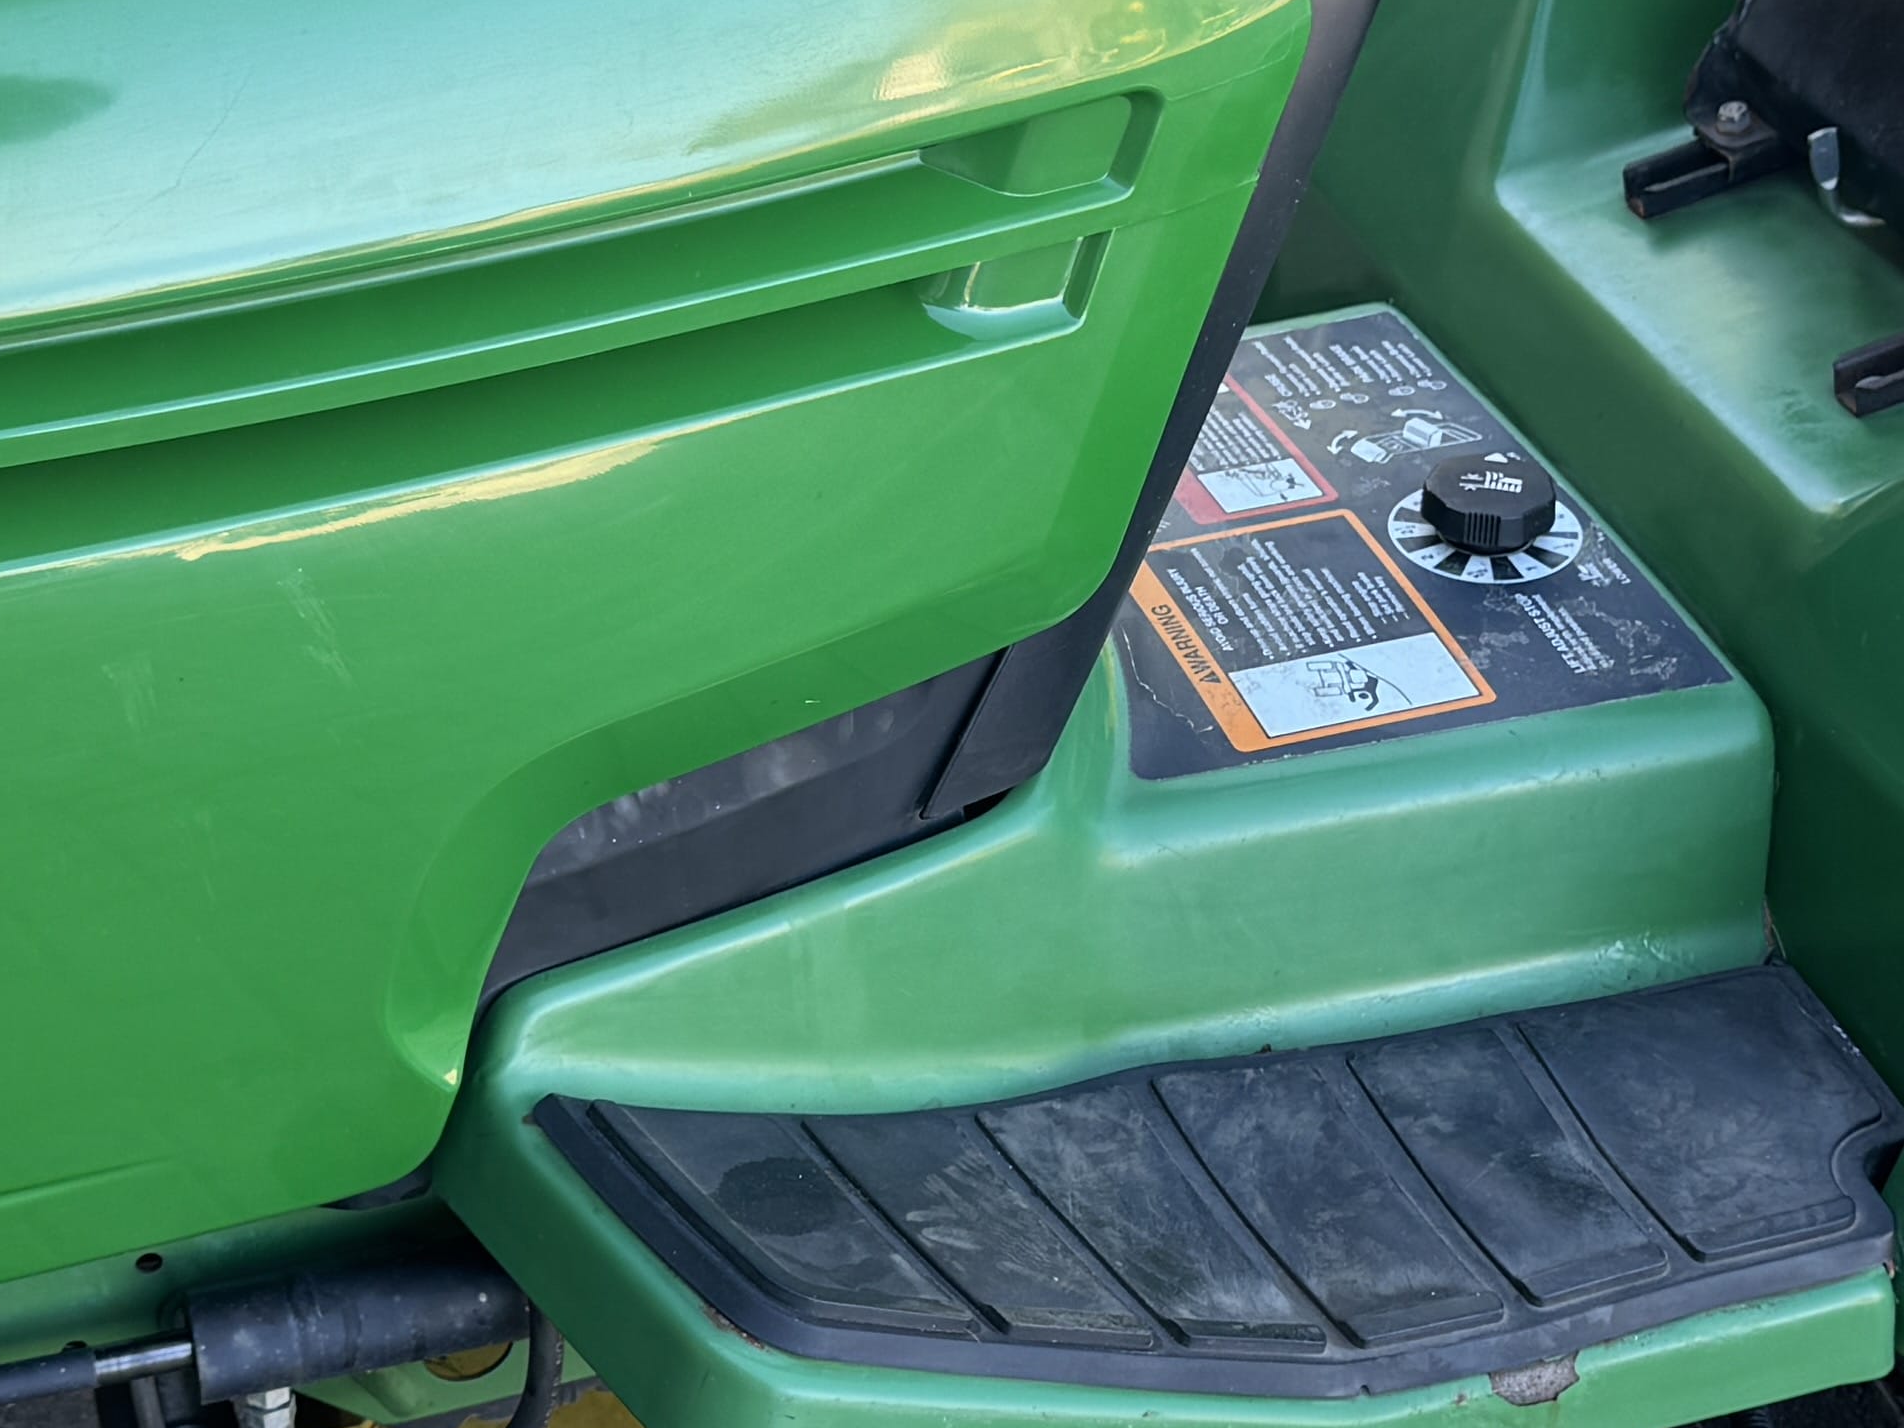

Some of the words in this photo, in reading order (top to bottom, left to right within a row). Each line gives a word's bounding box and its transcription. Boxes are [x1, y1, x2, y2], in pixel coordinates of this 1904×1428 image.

[1166, 567, 1193, 594] INJURY
[1184, 593, 1216, 627] SERIOUS
[1195, 585, 1220, 611] DEATH
[1512, 590, 1540, 618] STOP
[1212, 610, 1229, 624] OR
[1150, 603, 1213, 674] WARNING
[1207, 626, 1233, 652] AVOID
[1532, 615, 1569, 654] ADJUST
[1560, 650, 1586, 674] LIFT
